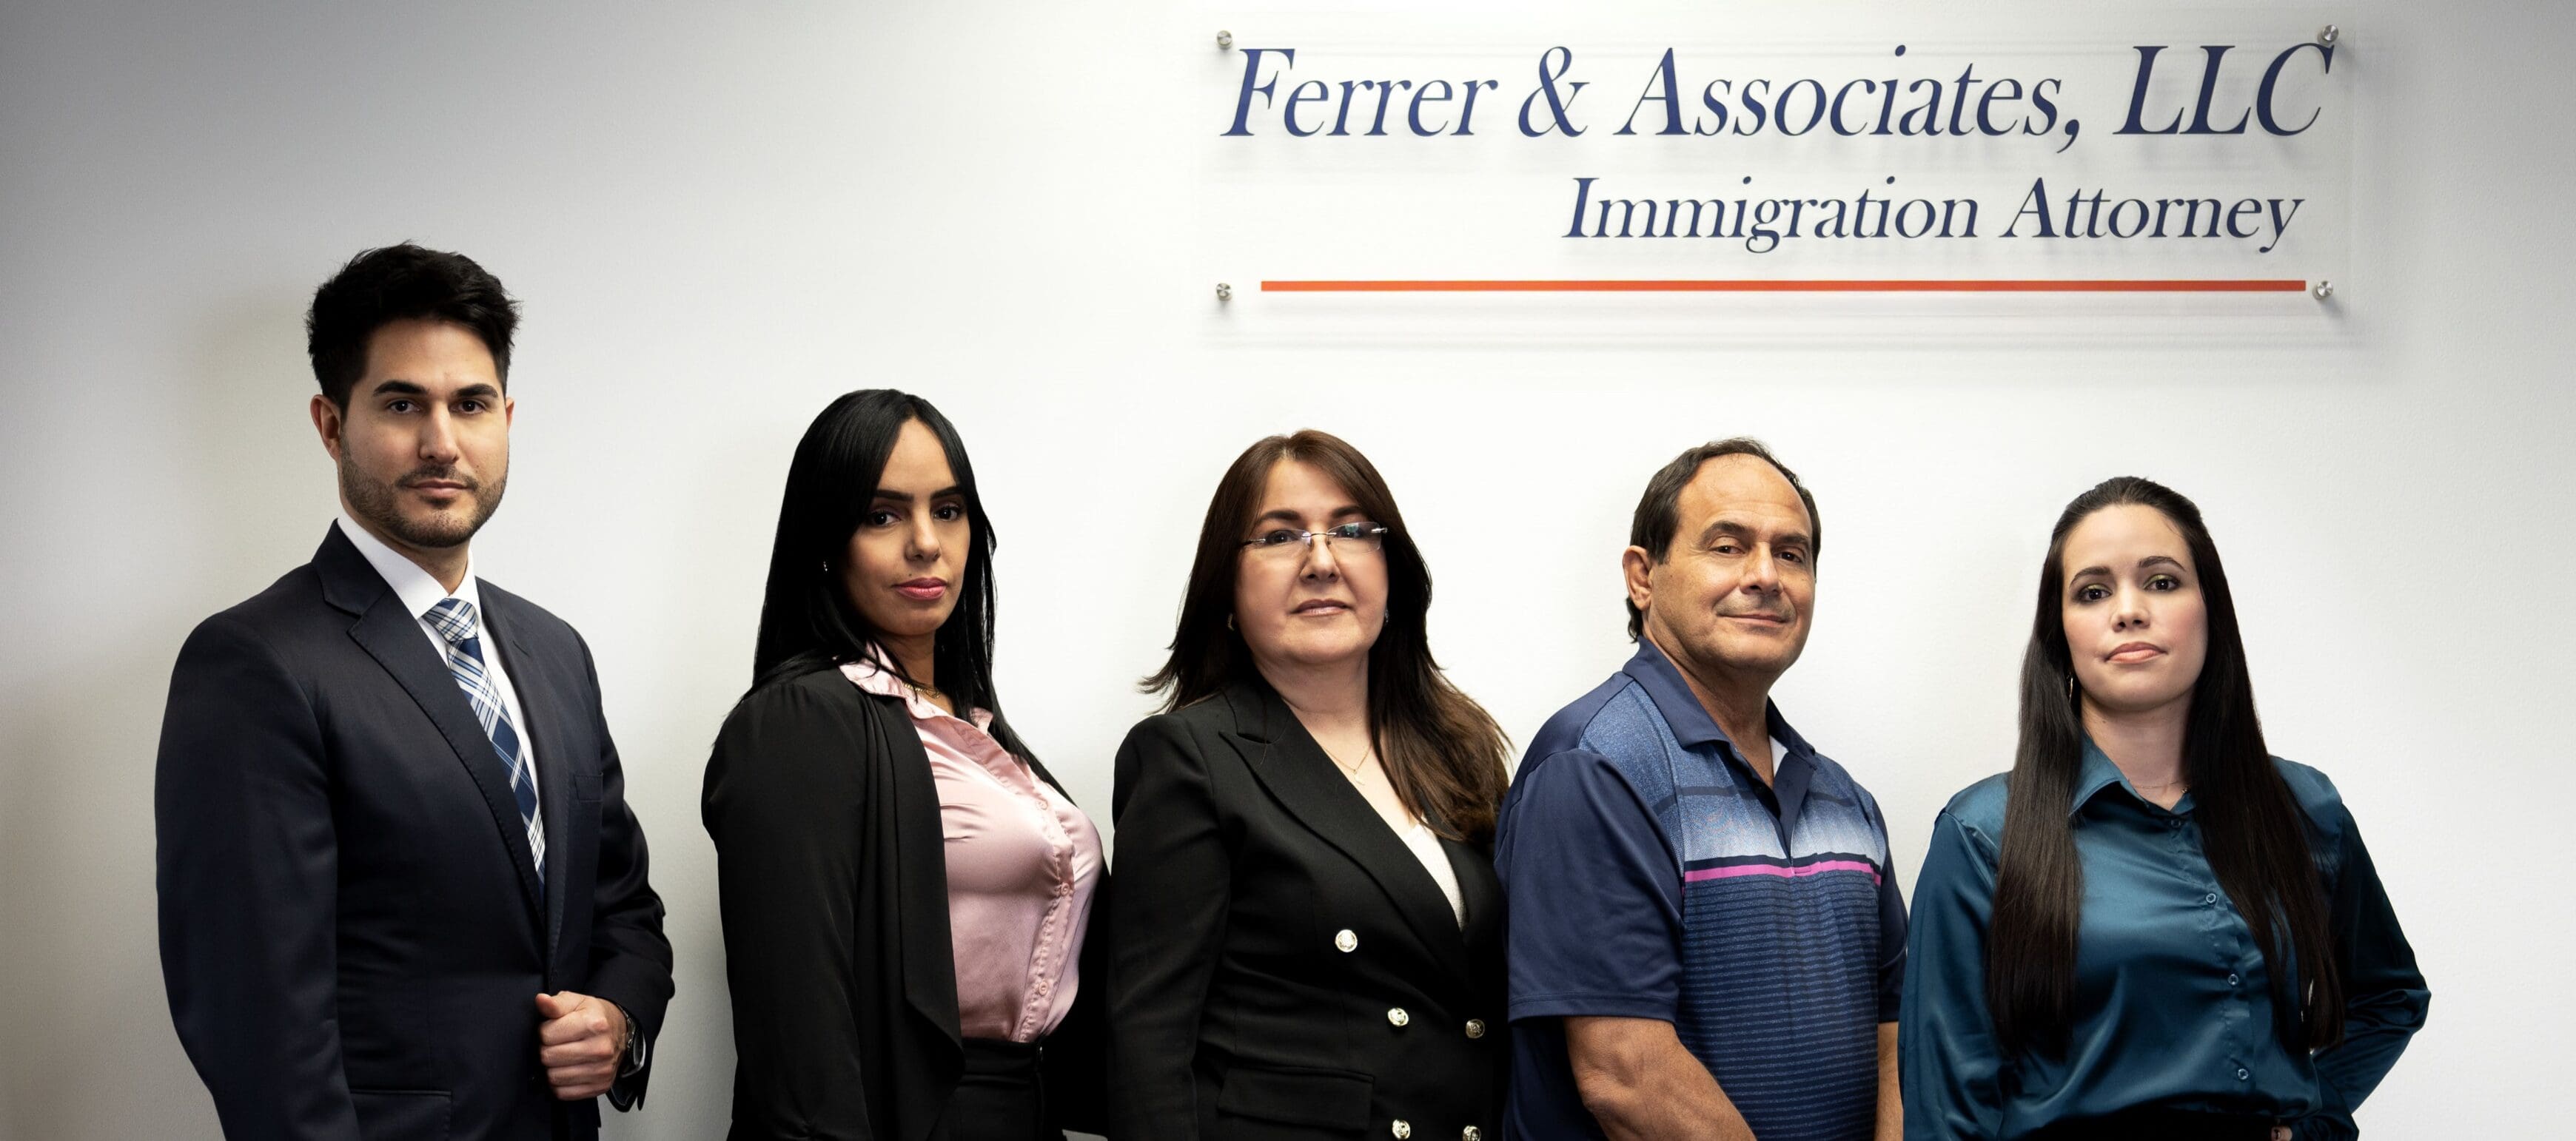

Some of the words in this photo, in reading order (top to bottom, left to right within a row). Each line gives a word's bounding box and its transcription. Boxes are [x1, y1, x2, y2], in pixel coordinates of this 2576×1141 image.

[1220, 47, 1498, 137] Ferrer
[1517, 46, 1590, 138] &
[1613, 44, 2081, 153] Associates,
[2113, 42, 2335, 137] LLC
[1562, 176, 1978, 254] Immigration
[1999, 177, 2305, 254] Attorney
